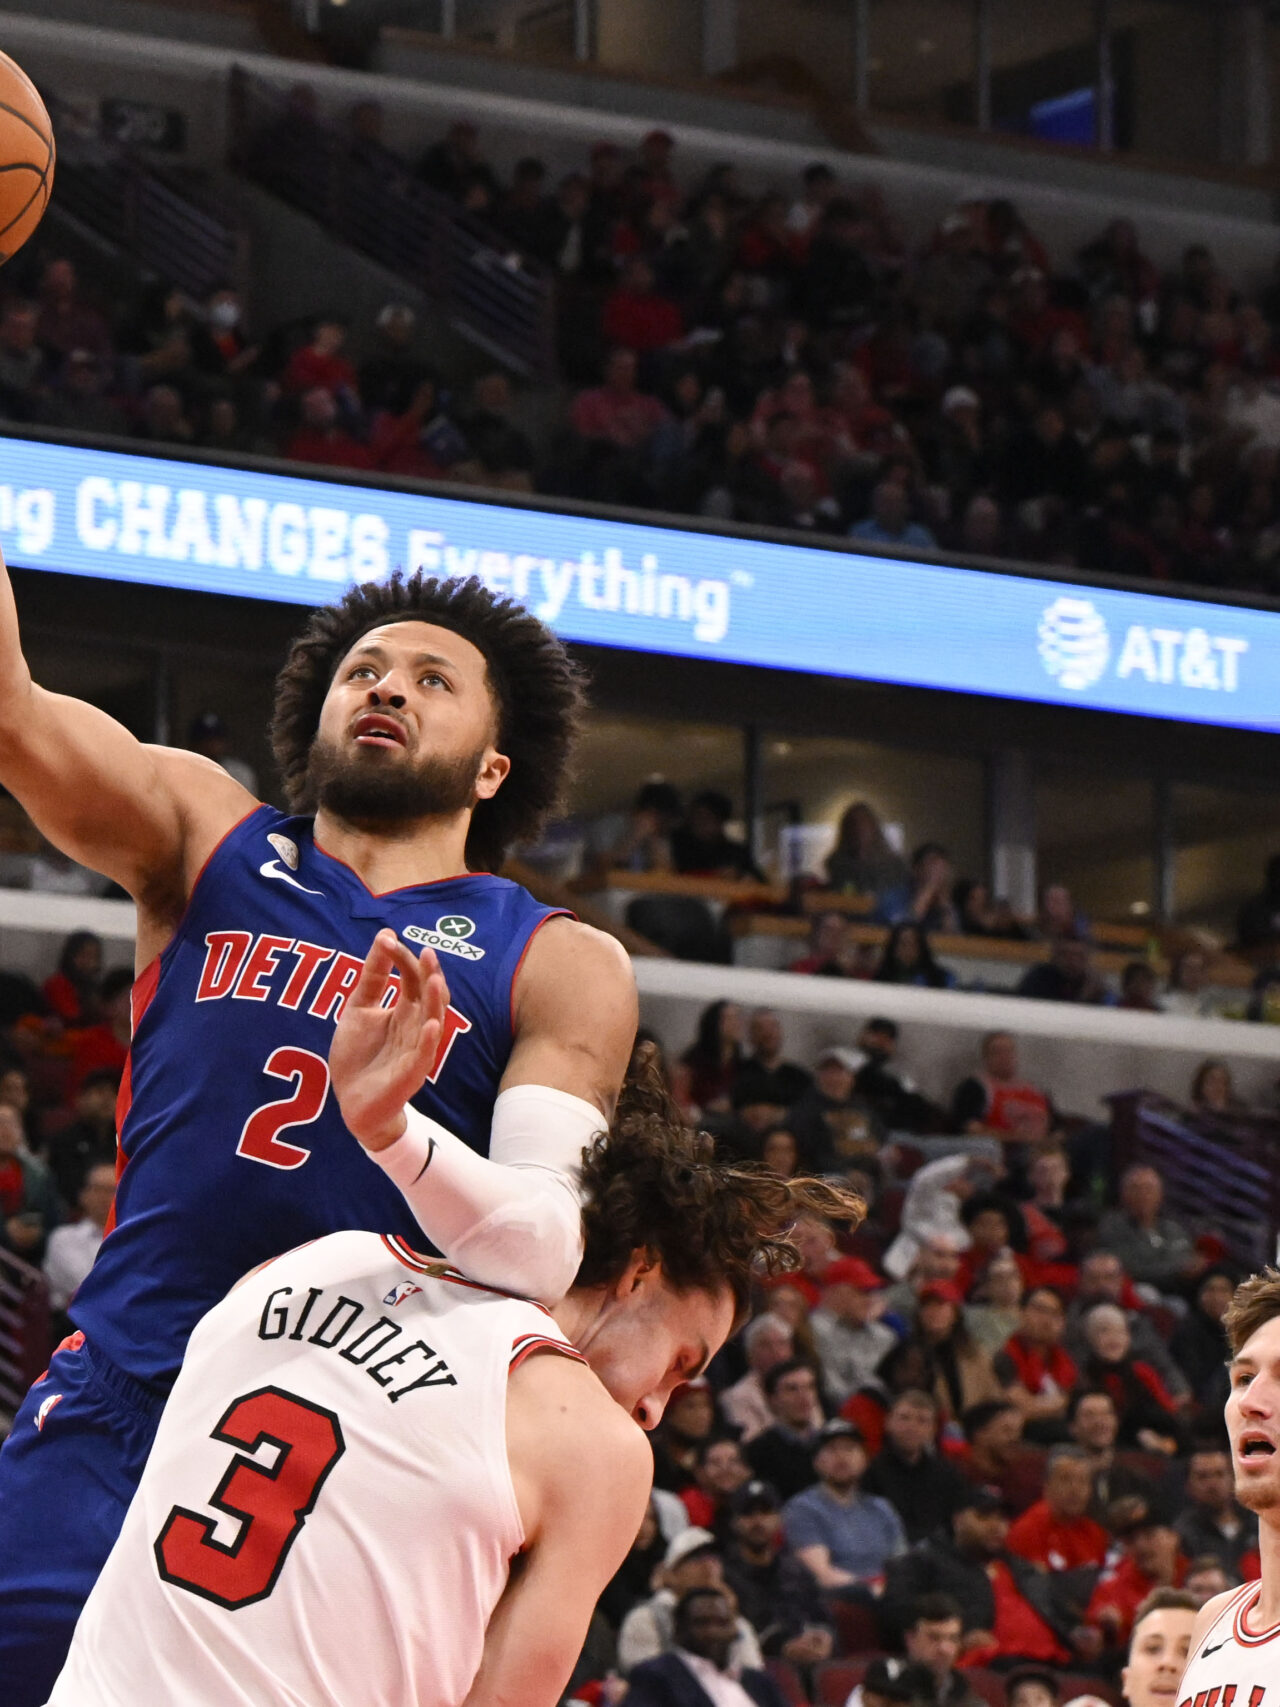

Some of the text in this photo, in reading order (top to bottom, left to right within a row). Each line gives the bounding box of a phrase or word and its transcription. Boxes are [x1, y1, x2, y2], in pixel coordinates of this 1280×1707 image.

[76, 476, 389, 582] CHANGES
[1117, 625, 1248, 692] AT&T
[195, 931, 472, 1084] DETRT
[236, 1046, 331, 1170] 2
[258, 1286, 458, 1404] GIDDEY
[153, 1385, 346, 1611] 3
